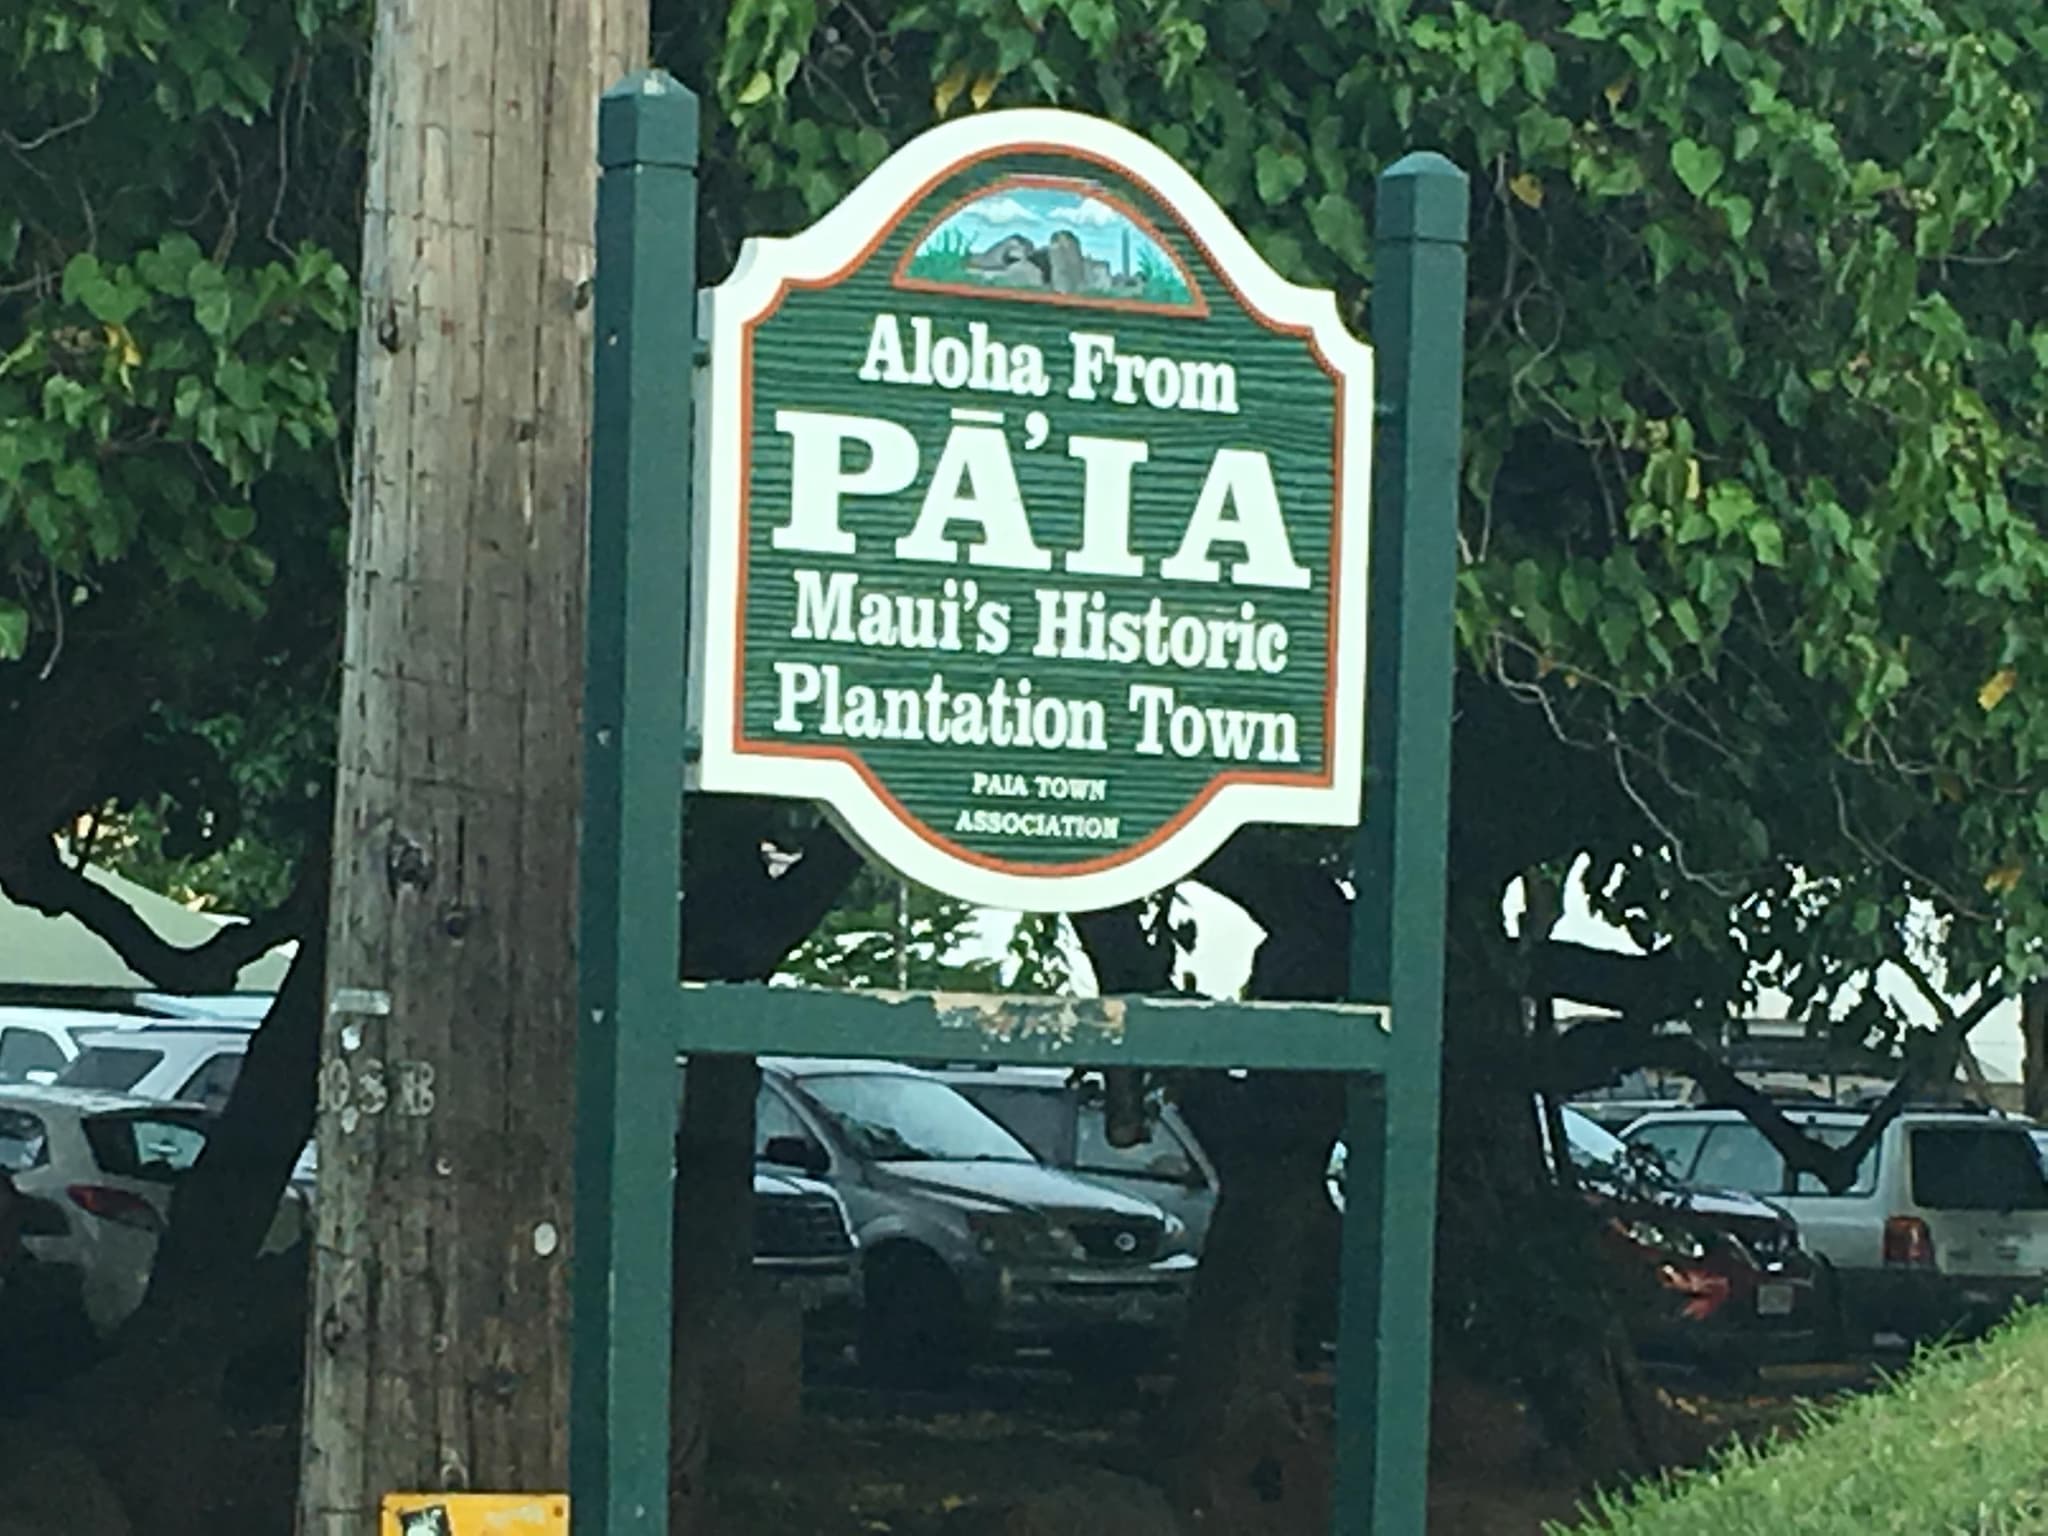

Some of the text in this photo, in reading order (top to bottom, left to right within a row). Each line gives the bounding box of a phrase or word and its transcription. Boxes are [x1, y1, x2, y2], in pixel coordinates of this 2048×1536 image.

[859, 314, 1239, 414] Aloha From
[791, 569, 1289, 674] Maui's Historic
[773, 662, 1300, 763] Plantation Town
[955, 809, 1119, 839] ASSOCIATION
[972, 772, 1107, 801] PAIA TOWN
